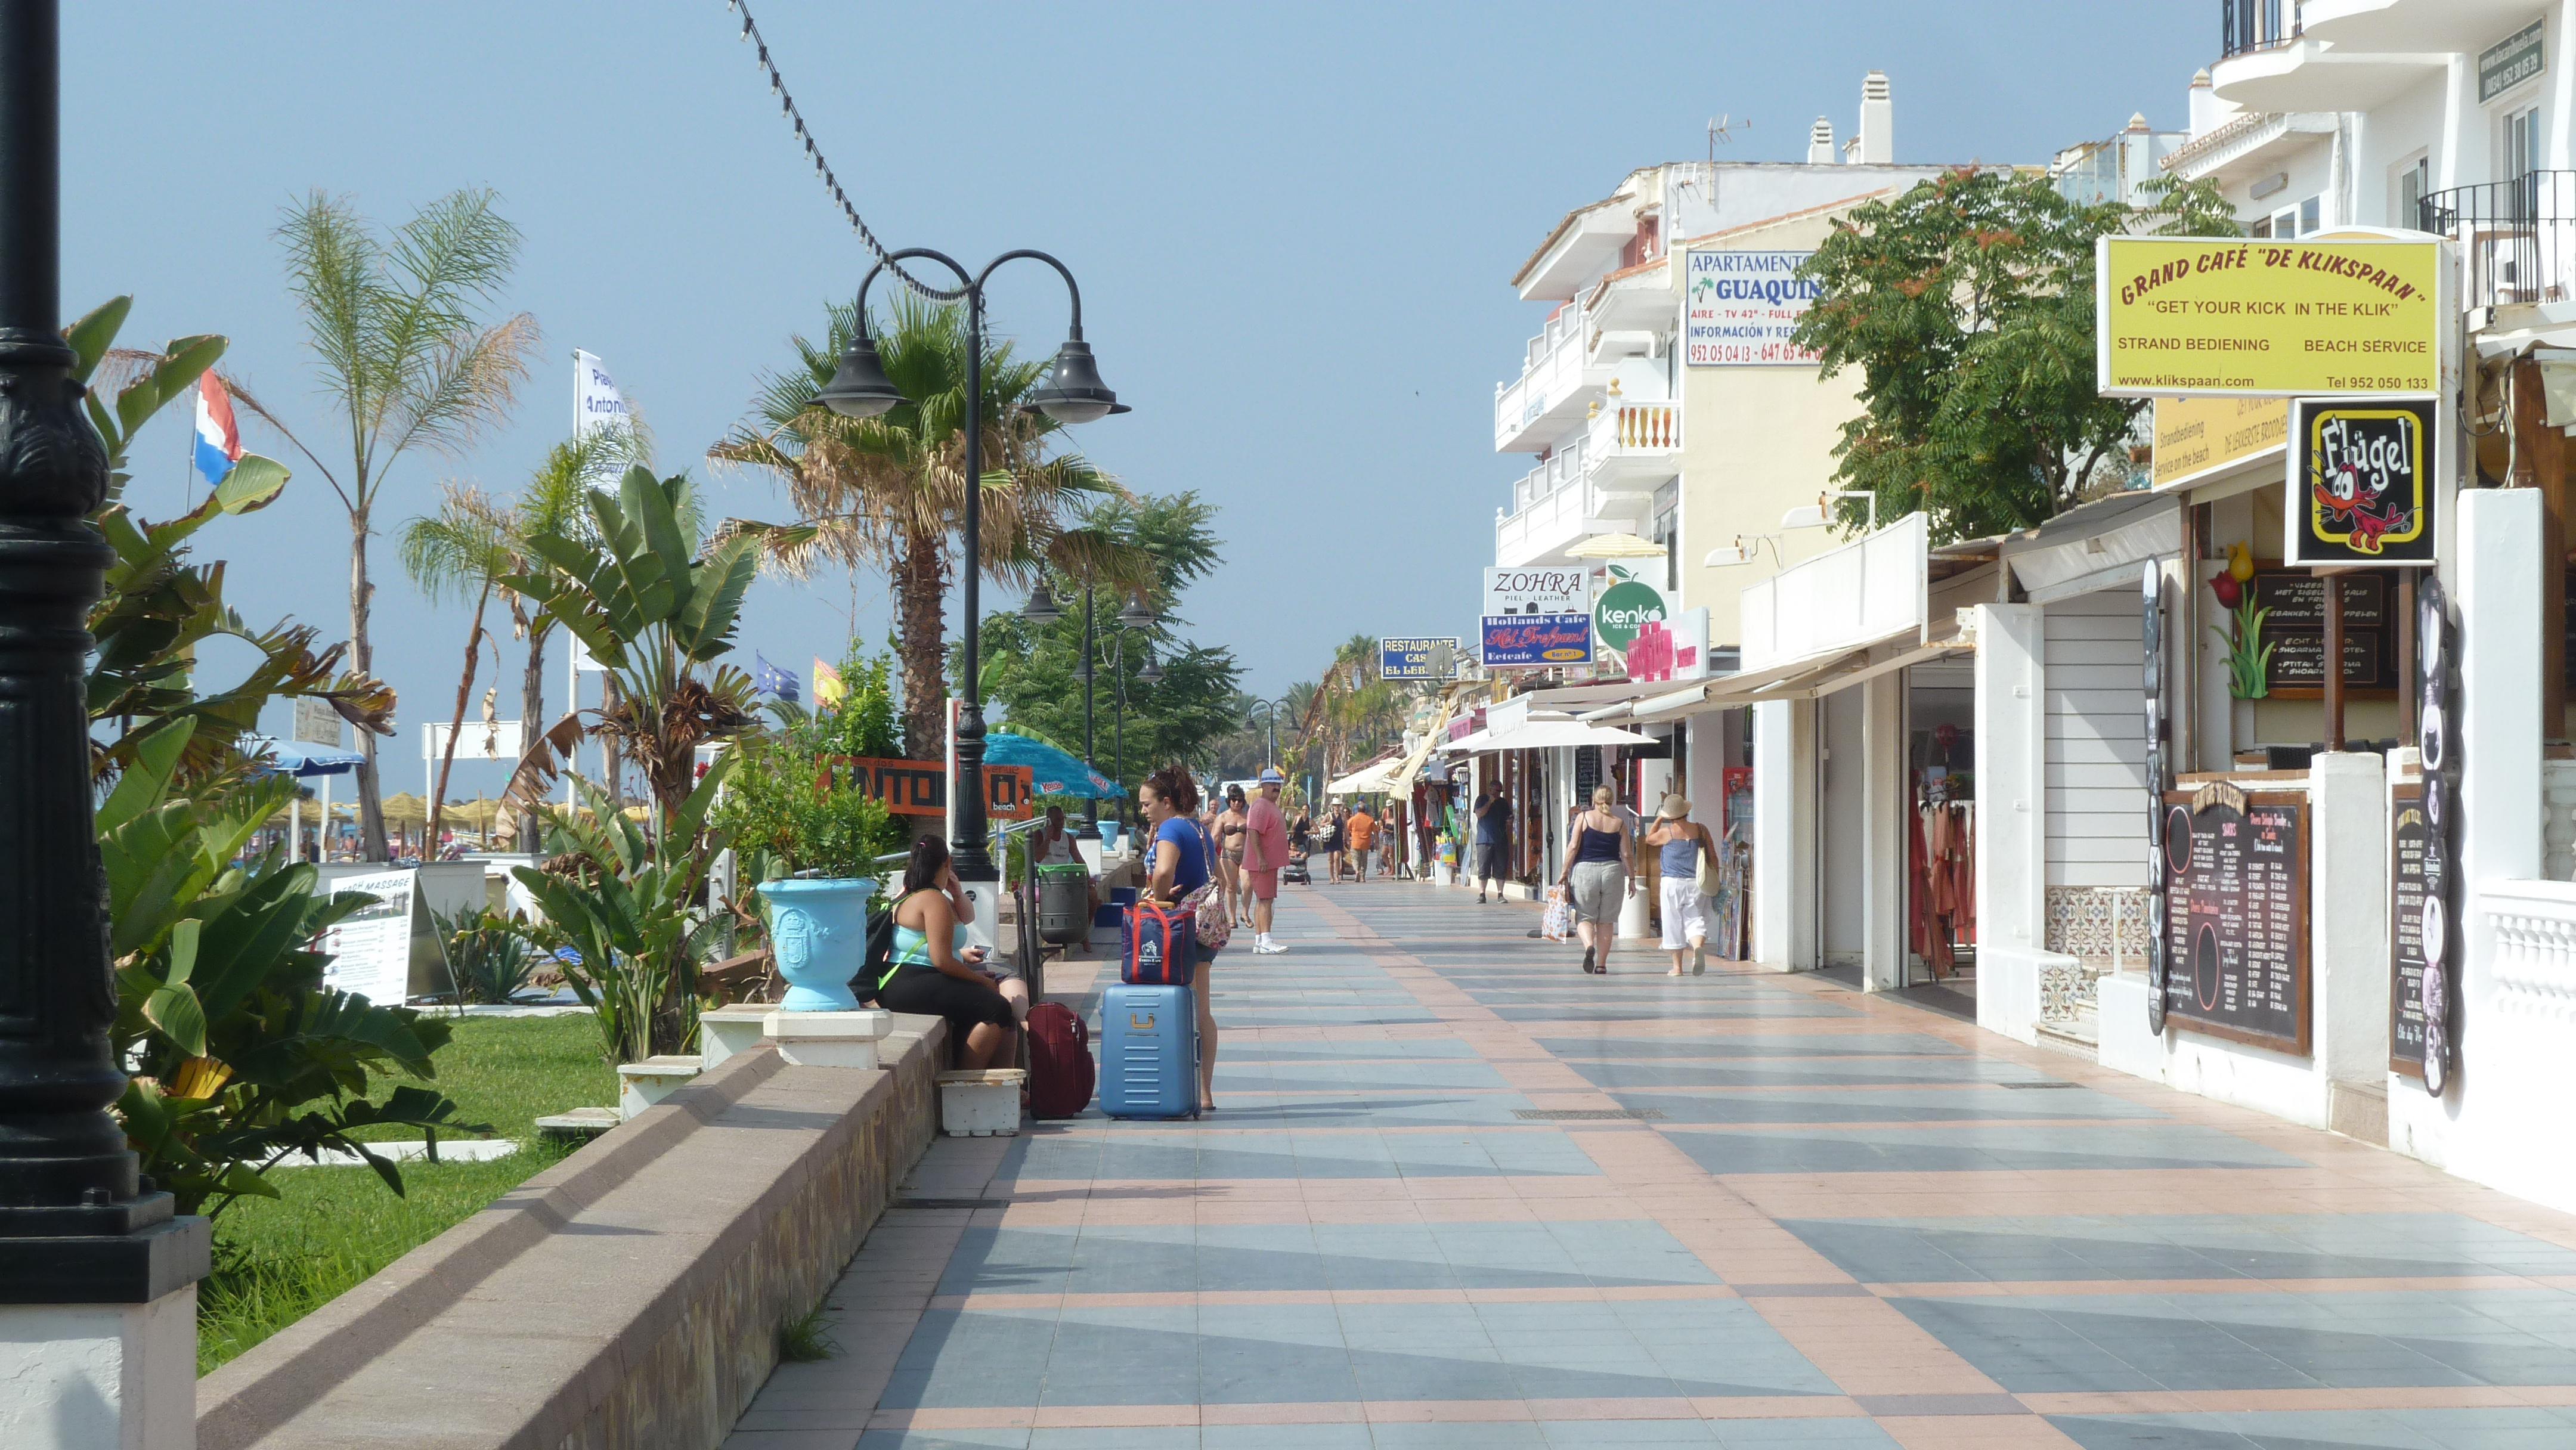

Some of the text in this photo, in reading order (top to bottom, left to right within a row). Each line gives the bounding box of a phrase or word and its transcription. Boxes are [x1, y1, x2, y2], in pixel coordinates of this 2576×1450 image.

[2503, 67, 2513, 86] 952
[2514, 62, 2521, 80] 38
[2522, 58, 2529, 76] 05
[2530, 52, 2538, 71] 39
[1692, 255, 1812, 272] APARTAMENT
[2121, 258, 2190, 306] GRAND
[2196, 244, 2249, 273] CAFÉ
[2297, 250, 2426, 303] KLIKSPAAN"
[1691, 309, 1714, 318] AIRE
[1725, 309, 1737, 318] TV
[1769, 309, 1792, 318] FULL
[2195, 301, 2241, 315] YOUR
[2246, 302, 2286, 315] KICK
[2295, 303, 2310, 315] IN
[2314, 303, 2348, 315] THE
[1690, 322, 1763, 337] INFORMACIÓN
[1766, 326, 1773, 337] Y
[2118, 337, 2270, 351] STRAND BEDIENING
[2304, 340, 2427, 354] BEACH SERVICE
[1691, 344, 1707, 361] 952
[1710, 345, 1722, 361] 05
[1725, 345, 1739, 362] 04
[1742, 345, 1751, 362] 13
[1761, 343, 1779, 360] 647
[1784, 343, 1794, 360] 65
[2119, 374, 2254, 389] www.klikspaan.com
[2327, 377, 2428, 389] Tel 952 050 133
[2160, 419, 2205, 448] Strandbediening
[2321, 413, 2411, 491] Flügel
[2154, 444, 2209, 478] Service on the beach
[1494, 572, 1581, 595] ZOHRA
[1487, 616, 1550, 625] Hollands
[1405, 653, 1426, 662] CAS
[1385, 666, 1400, 674] EL
[993, 802, 1015, 811] beach
[364, 877, 410, 891] MASSAGE
